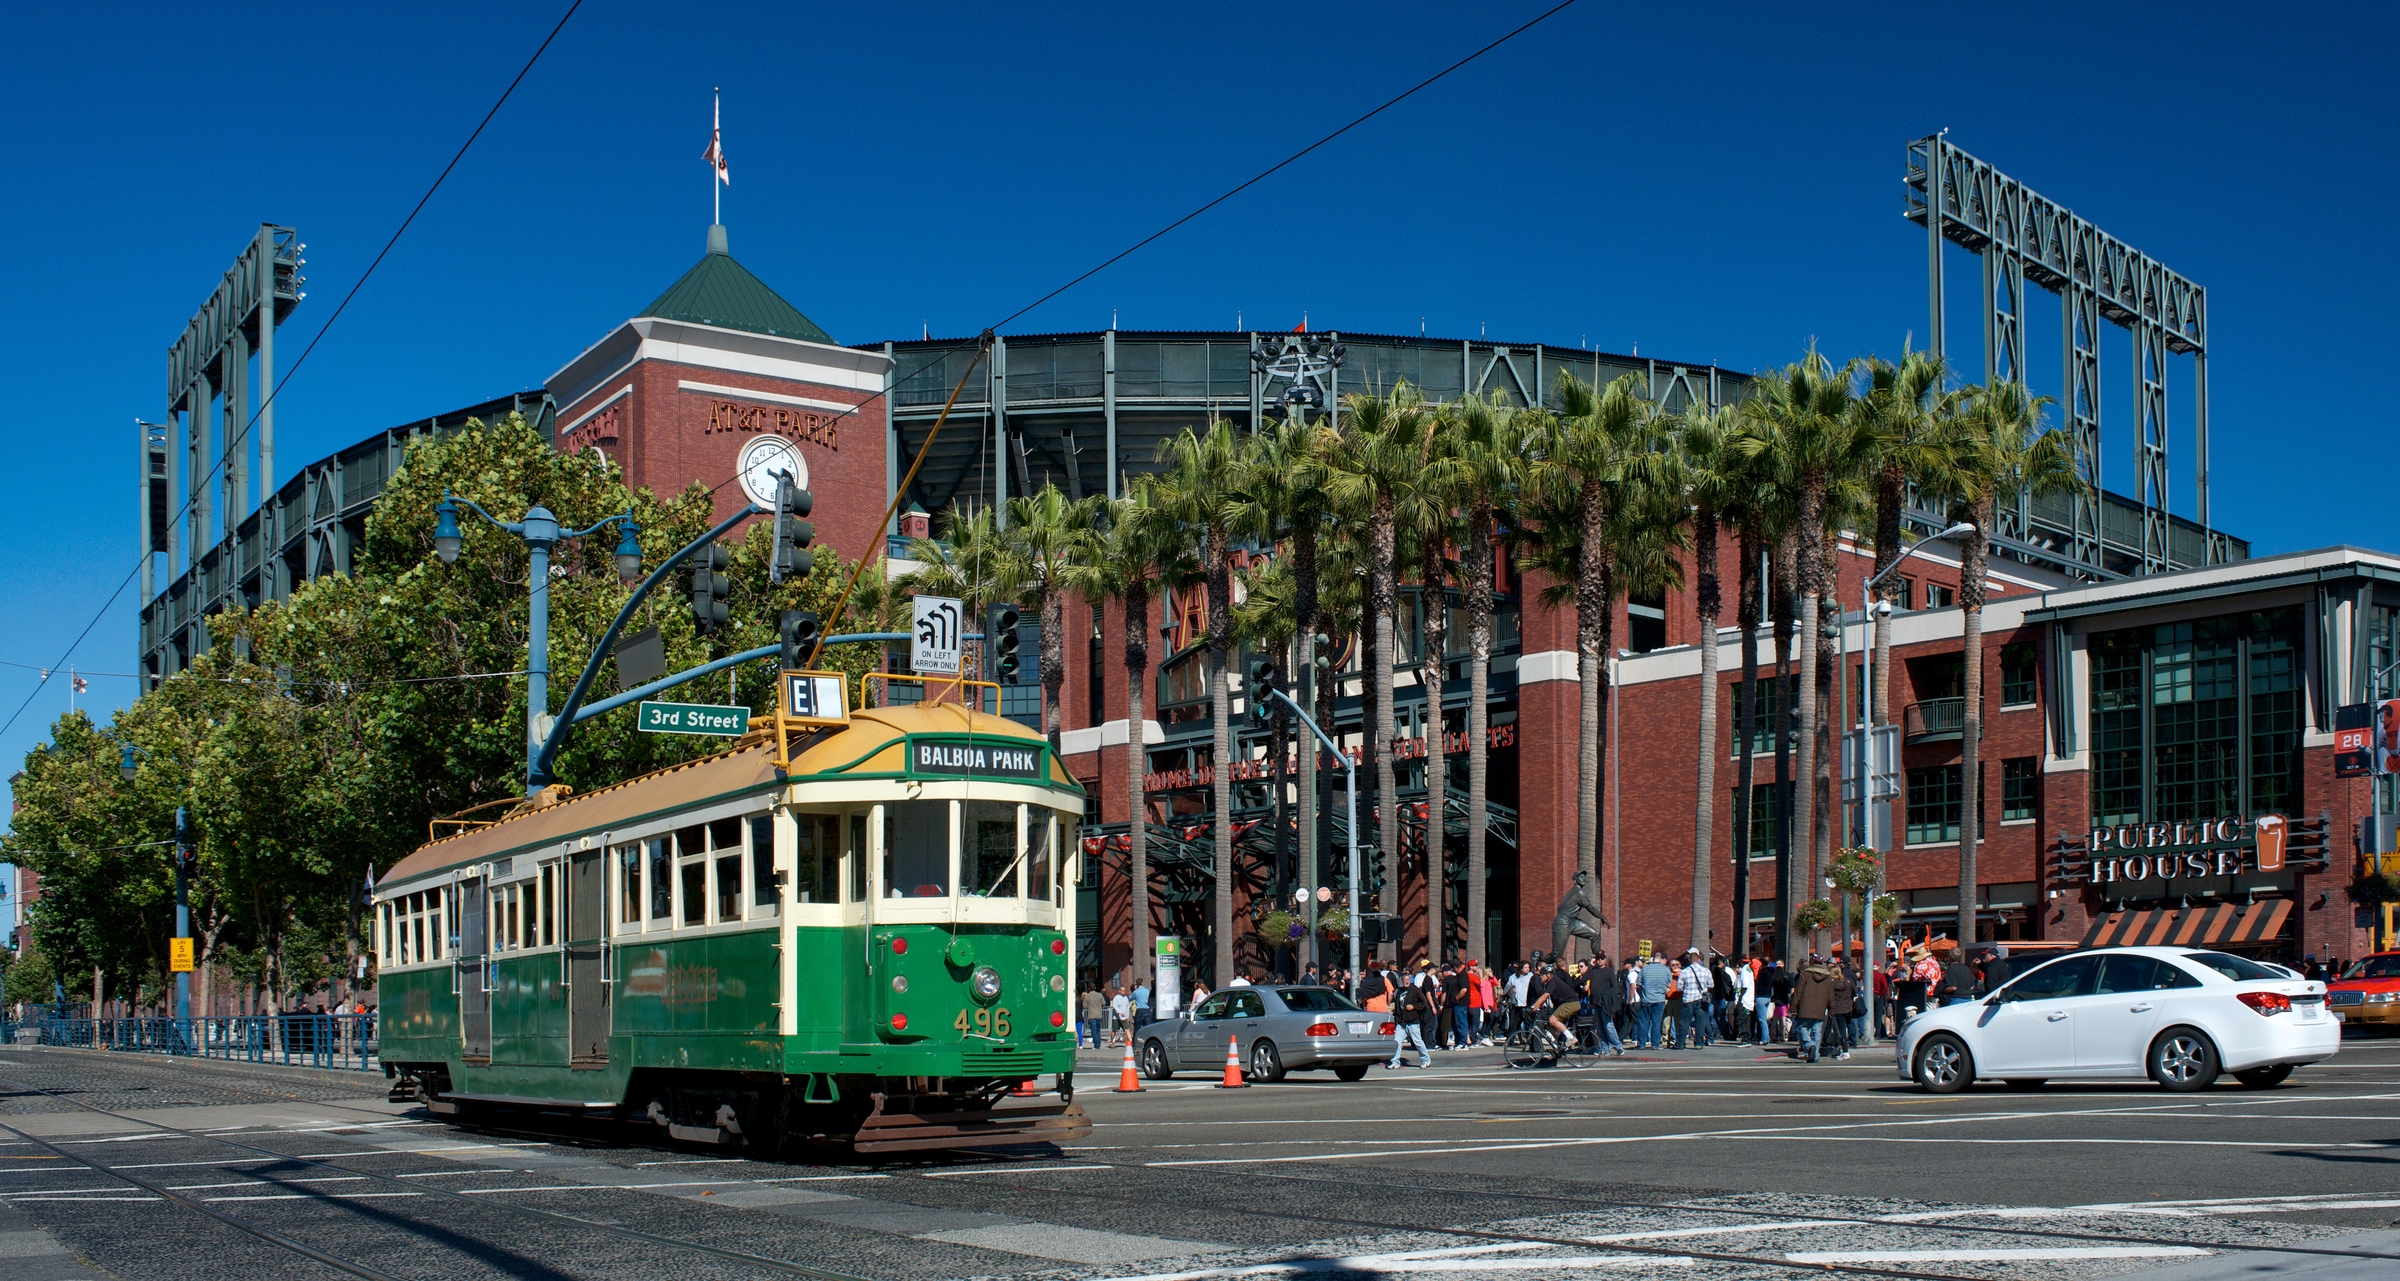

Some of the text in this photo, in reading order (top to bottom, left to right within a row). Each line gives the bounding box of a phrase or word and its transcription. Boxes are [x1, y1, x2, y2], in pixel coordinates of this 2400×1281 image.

[705, 400, 838, 452] AT&T PARK
[759, 448, 766, 457] 11
[787, 460, 793, 468] 2
[751, 478, 757, 487] 8
[760, 487, 765, 495] 7
[921, 650, 952, 660] ON LEFT
[914, 659, 958, 670] ARROW ONLY
[793, 680, 809, 713] E
[650, 709, 739, 729] 3rd Street
[2342, 733, 2362, 748] 28
[921, 746, 1035, 771] BALBOA PARK
[1143, 768, 1193, 793] HOME
[1228, 758, 1264, 782] THE
[2090, 815, 2243, 852] PUBLIC
[2090, 848, 2243, 884] HOUSE
[179, 945, 185, 953] 5
[953, 1007, 1012, 1039] 496
